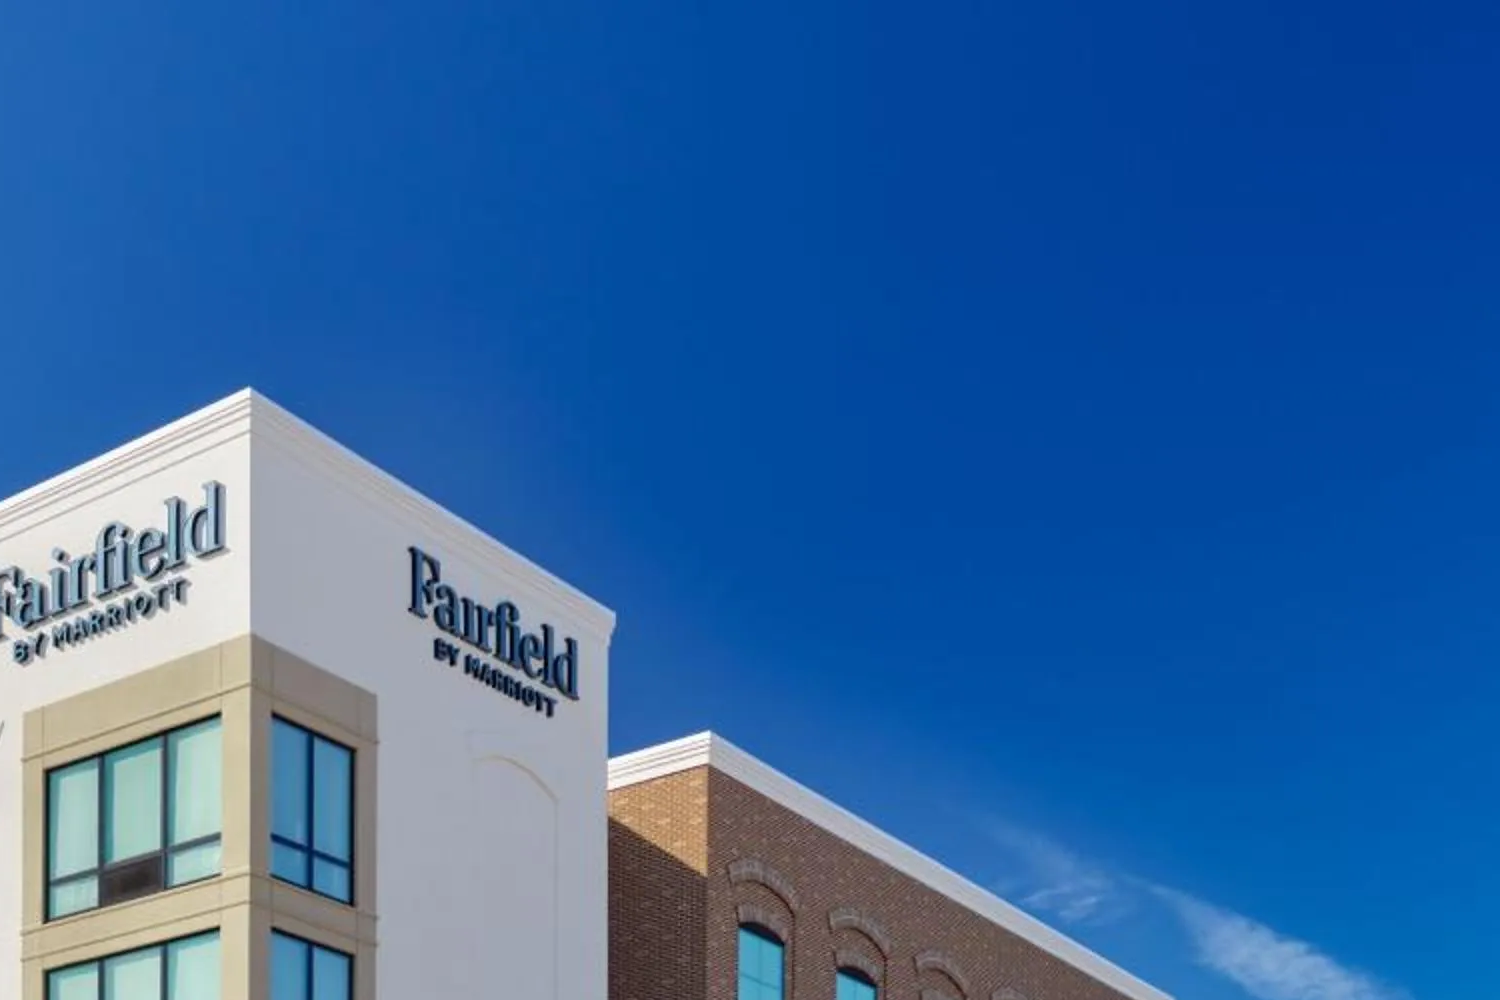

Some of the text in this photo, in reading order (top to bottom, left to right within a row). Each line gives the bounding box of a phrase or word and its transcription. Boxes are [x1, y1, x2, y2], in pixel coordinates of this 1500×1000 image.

[12, 576, 192, 666] BY MARRIOTT
[408, 546, 580, 701] Fairfield
[433, 638, 559, 719] BY MARRIOTT
